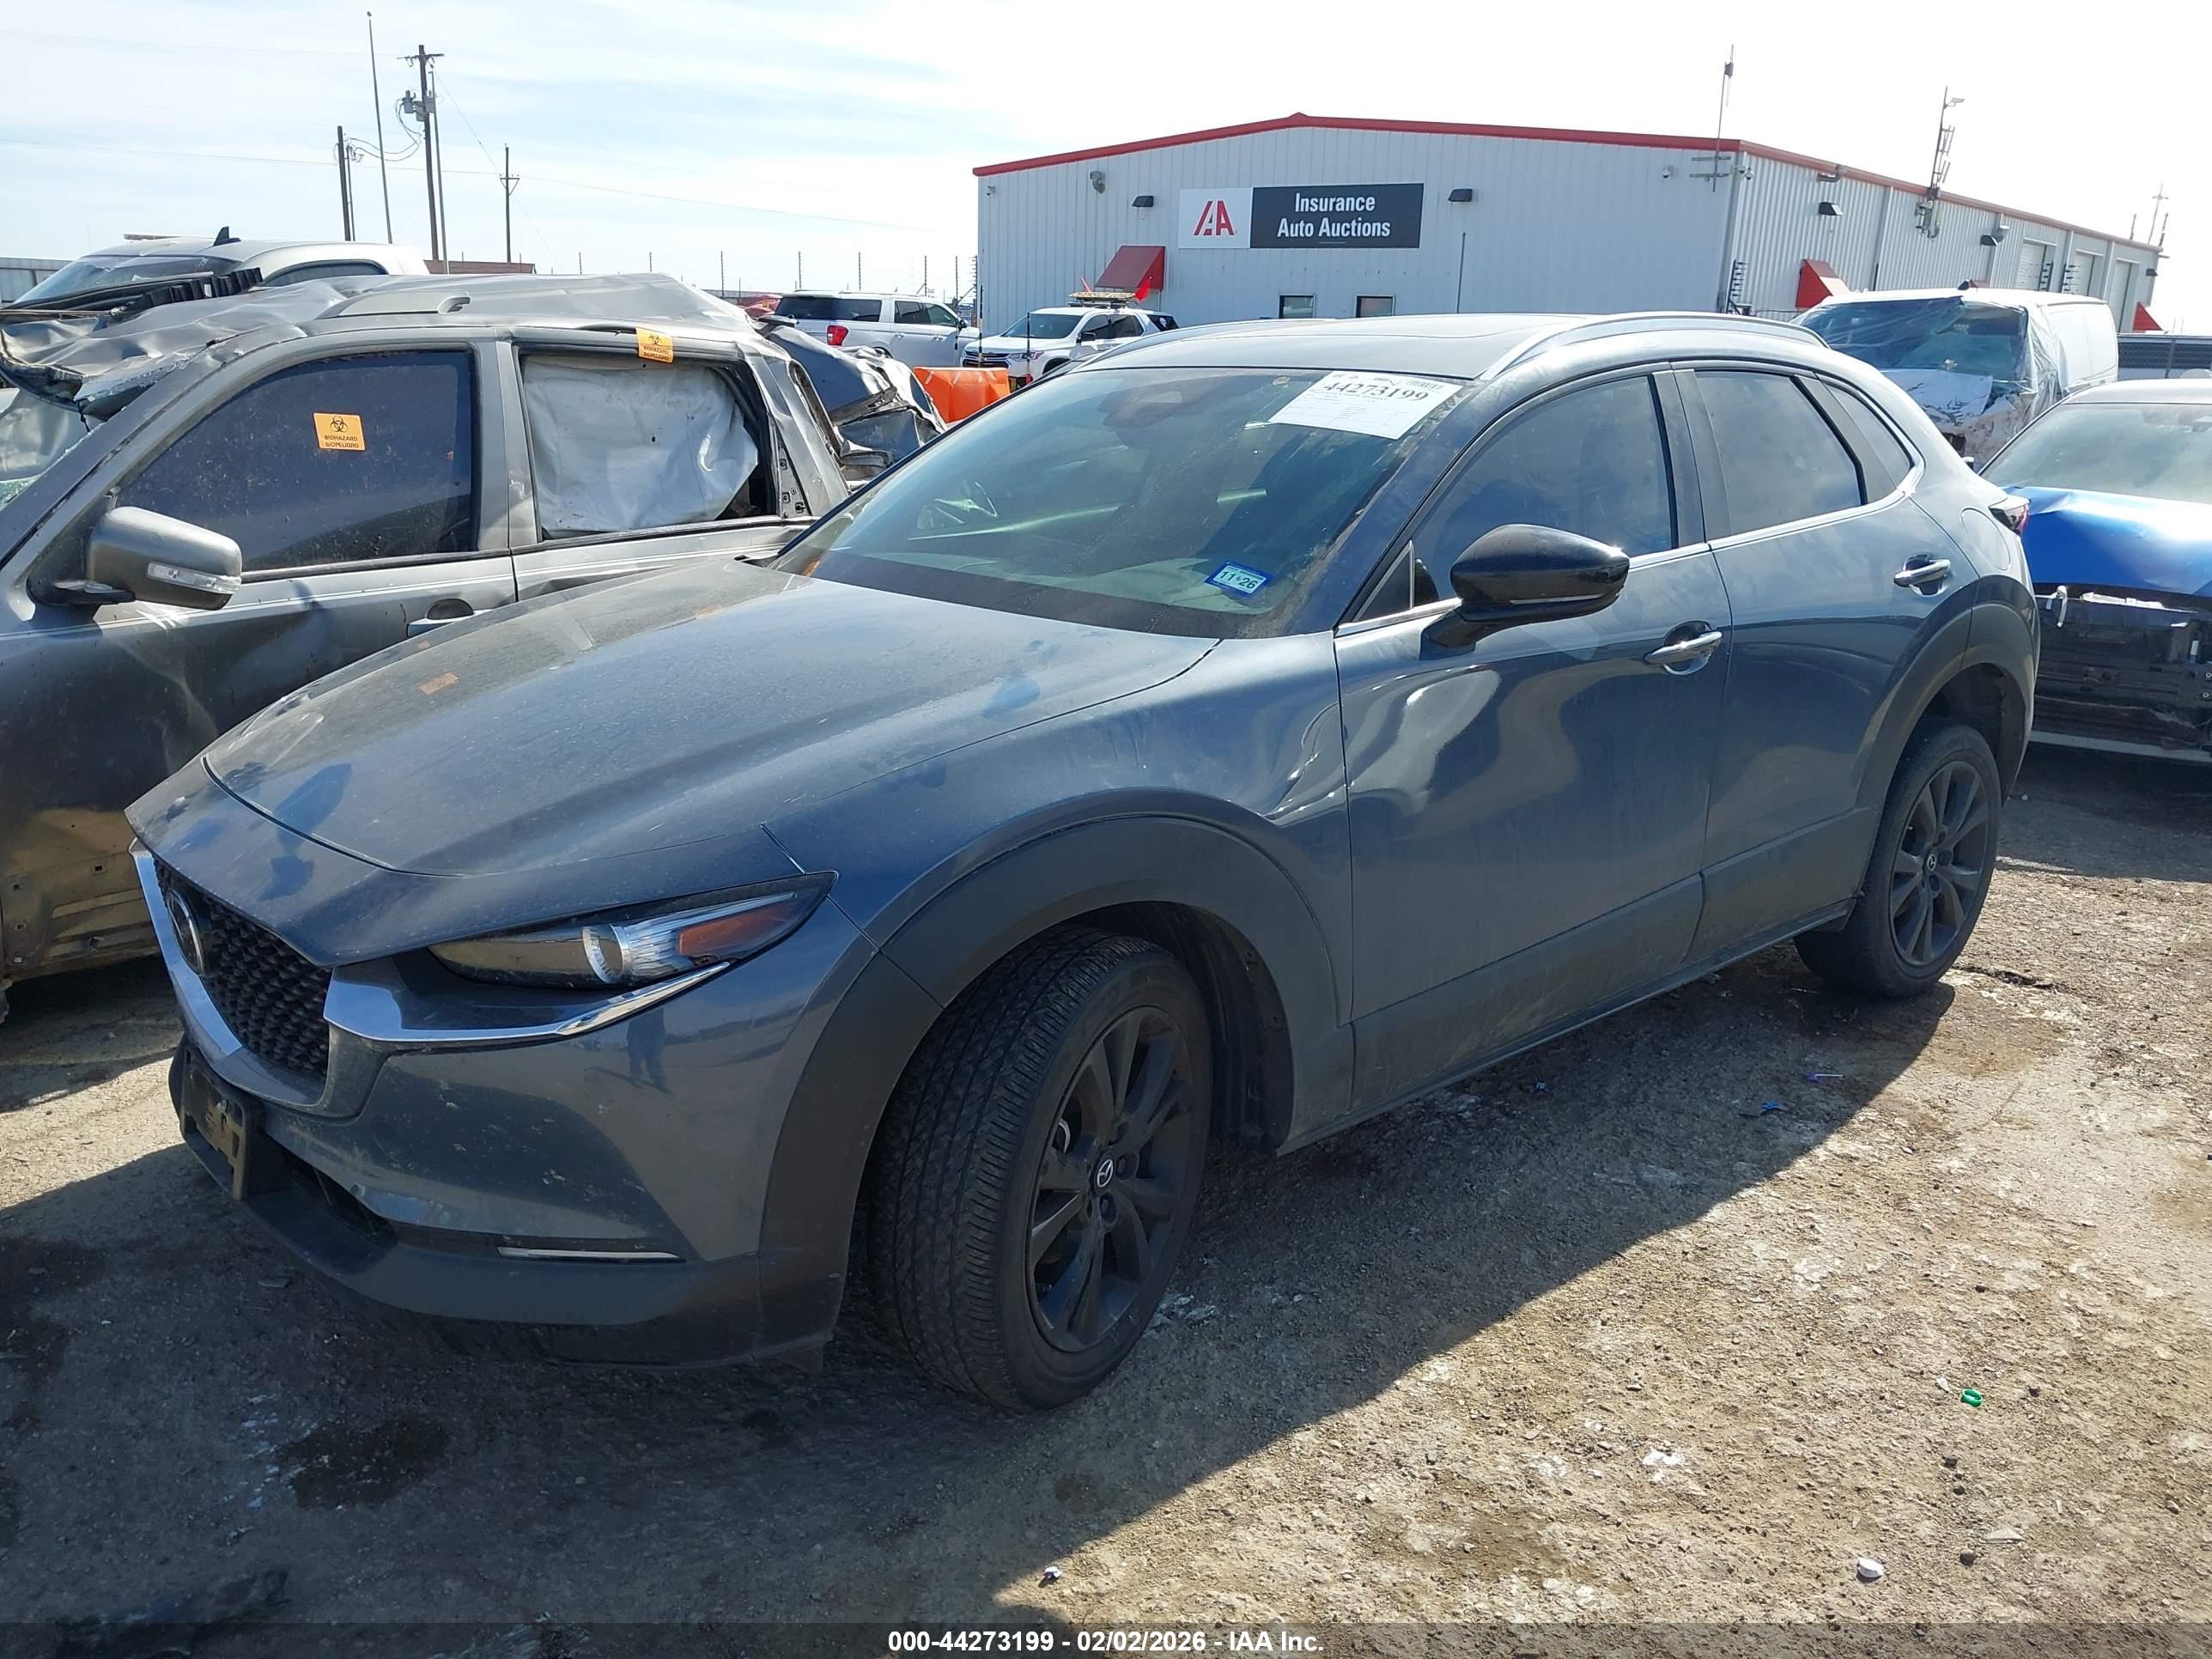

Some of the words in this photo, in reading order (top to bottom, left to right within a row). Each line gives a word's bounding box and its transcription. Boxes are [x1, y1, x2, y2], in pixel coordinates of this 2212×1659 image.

[1295, 192, 1376, 212] Insurance
[1277, 217, 1315, 237] Auto
[1318, 216, 1391, 237] Auctions
[1323, 381, 1429, 401] 44273199
